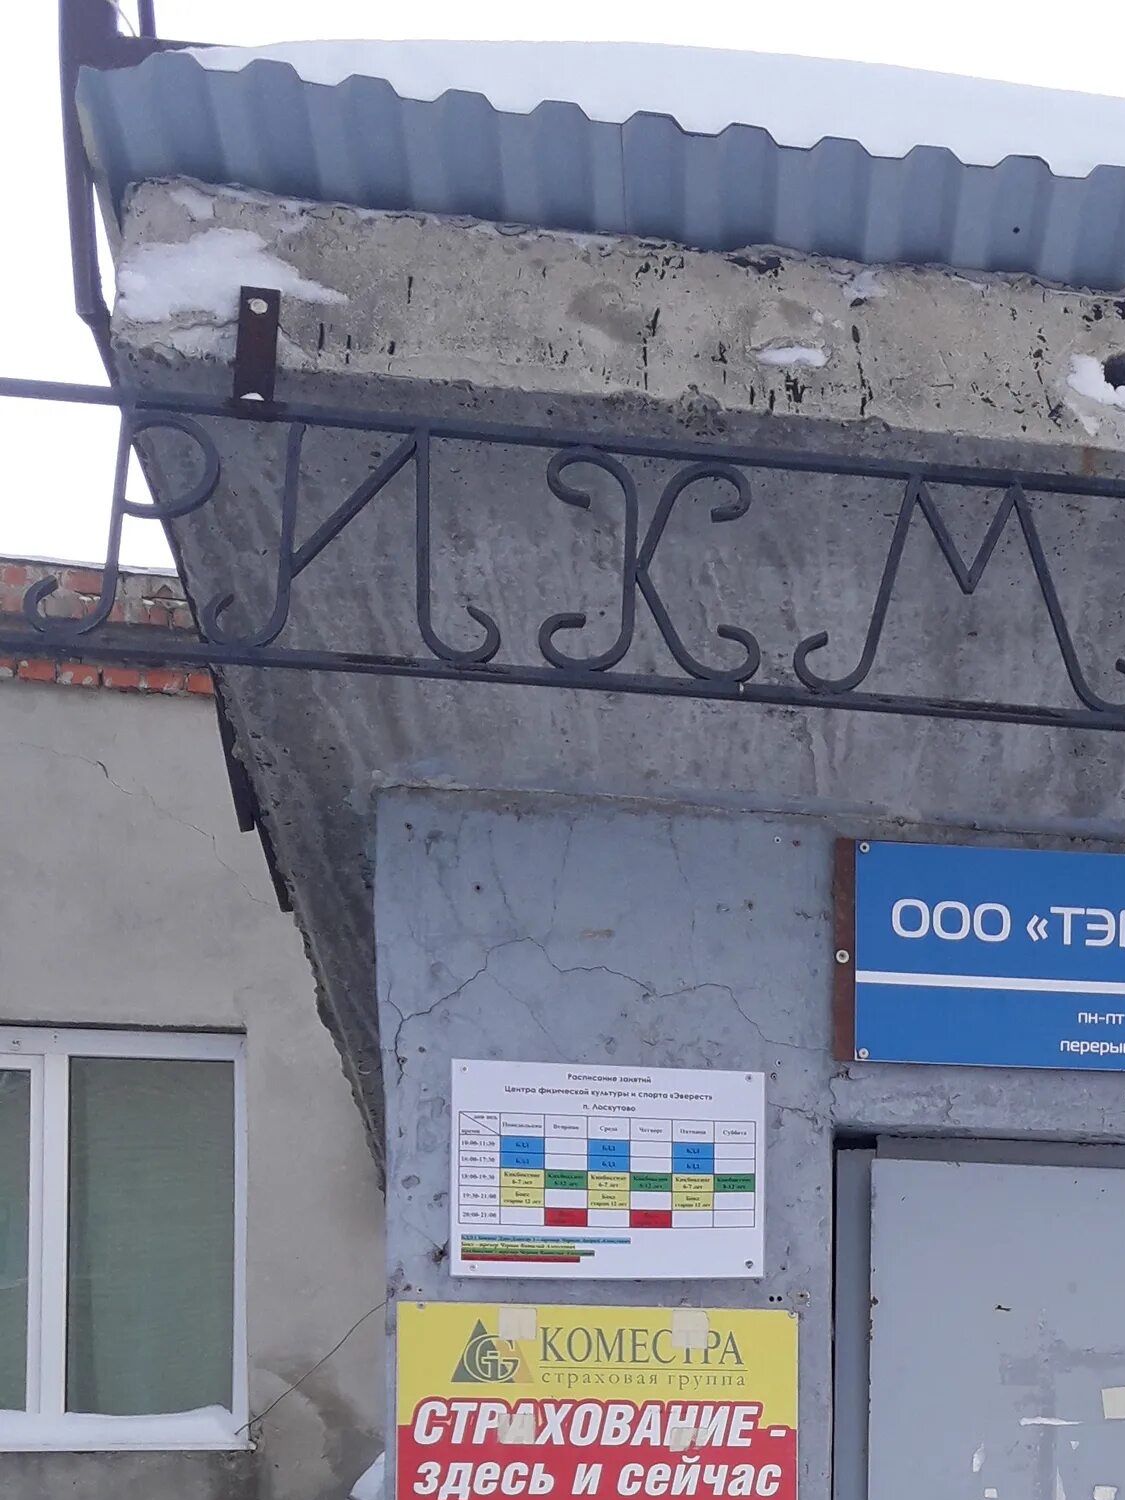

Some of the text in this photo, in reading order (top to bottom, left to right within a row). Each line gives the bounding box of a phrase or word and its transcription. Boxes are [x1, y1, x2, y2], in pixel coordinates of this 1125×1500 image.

[891, 899, 1011, 942] ООО
[1078, 1012, 1125, 1025] пн-пт
[567, 1073, 652, 1084] Расписание занятий
[504, 1085, 536, 1095] Центра
[538, 1086, 589, 1096] физической
[591, 1089, 629, 1100] культуры
[638, 1092, 668, 1101] спорта
[592, 1103, 636, 1114] Лоскутово
[541, 1372, 745, 1392] страховая группа
[413, 1401, 759, 1447] СТРАХОВАНИЕ
[413, 1455, 782, 1500] здесь и сейчас
